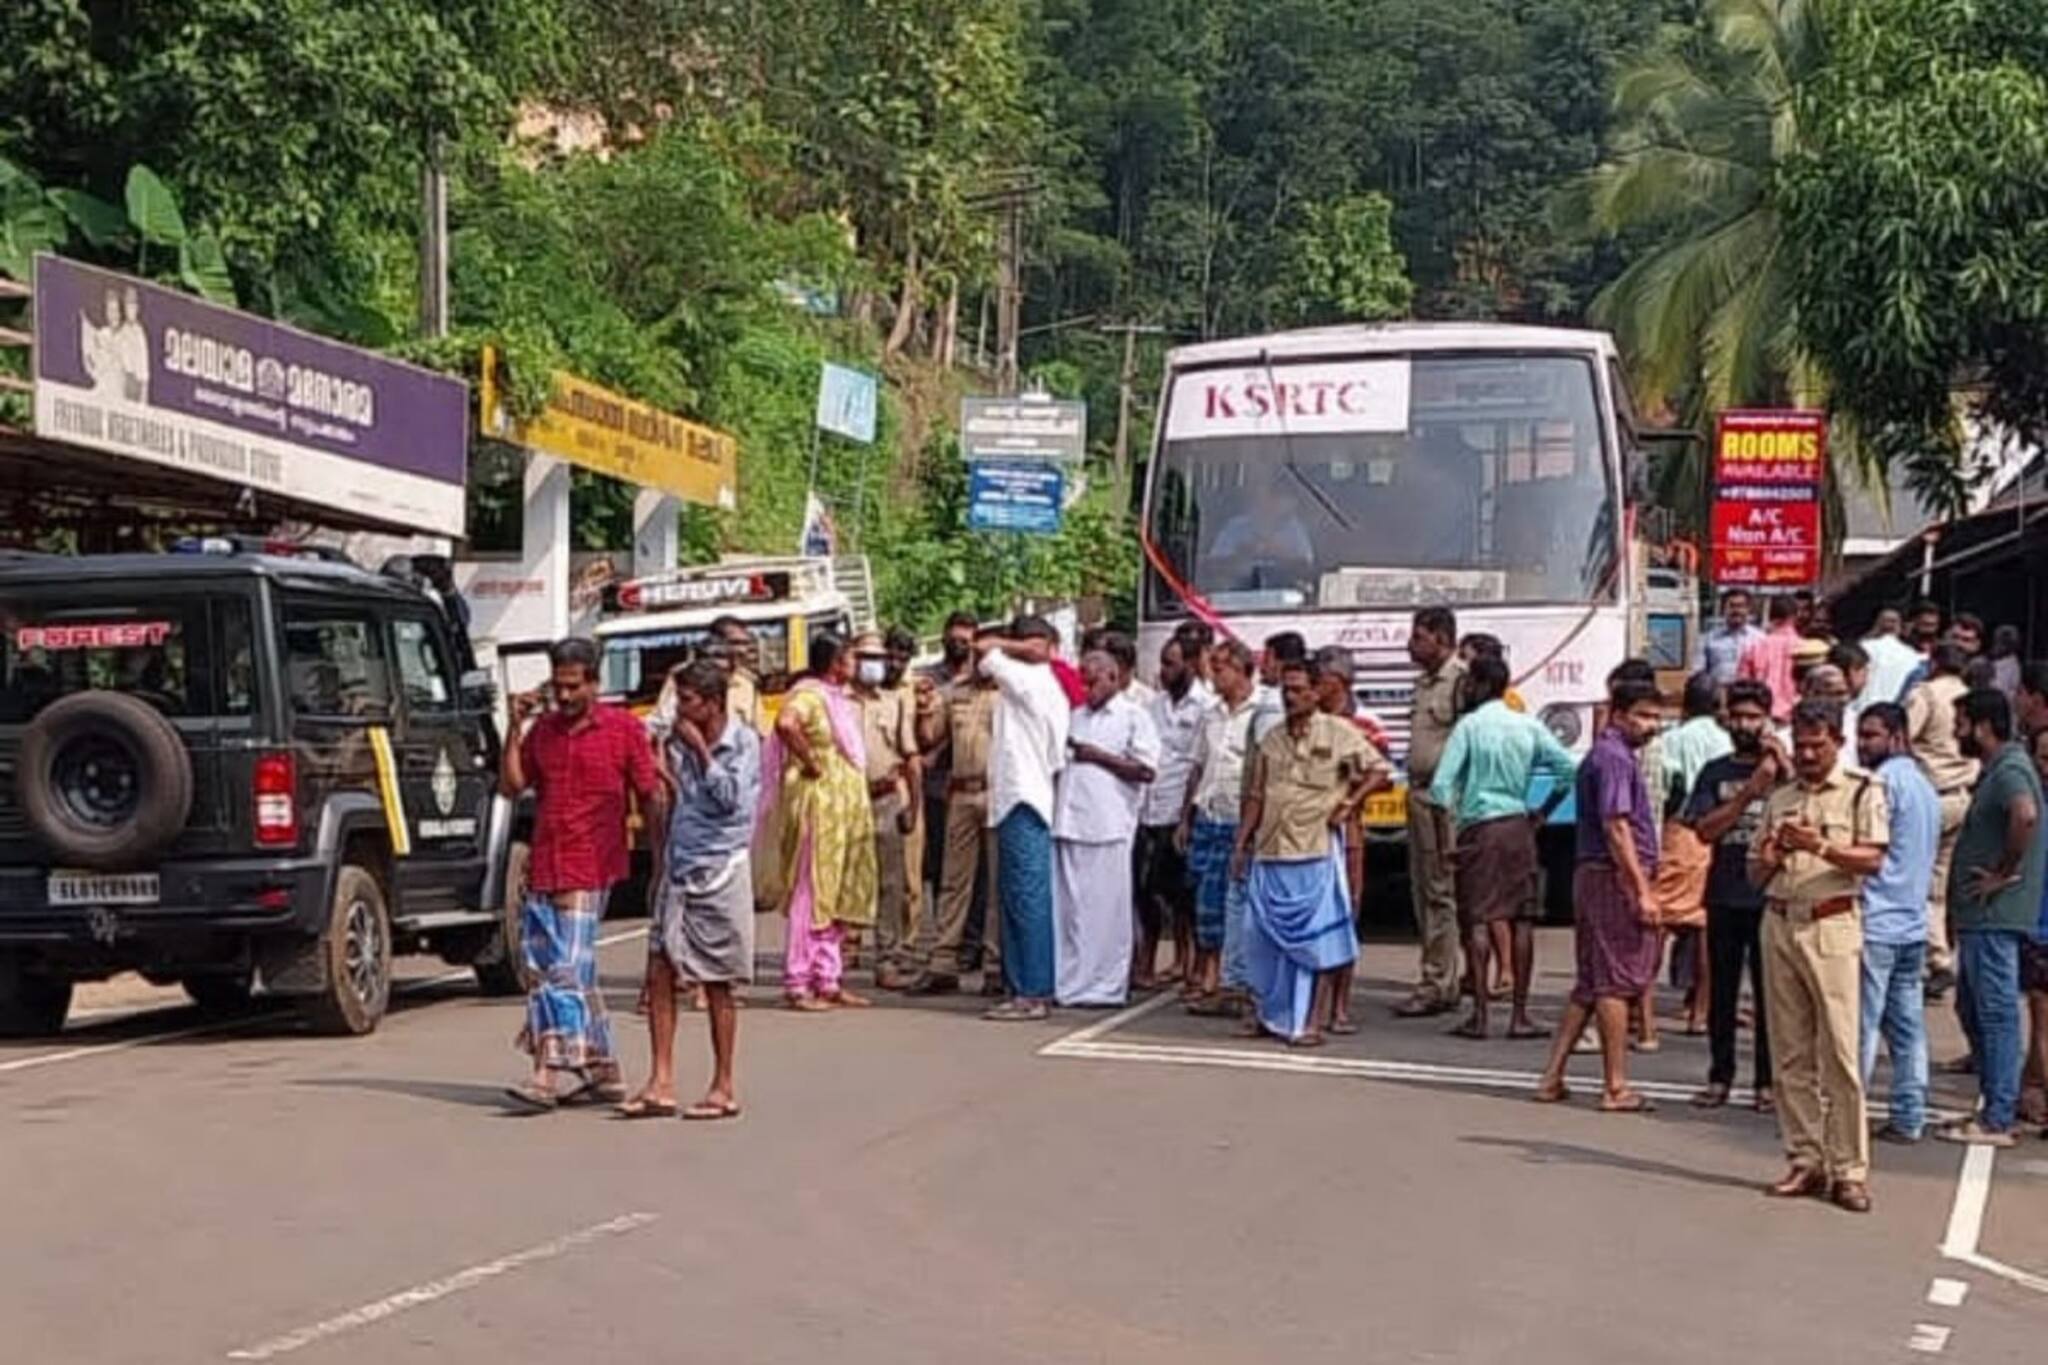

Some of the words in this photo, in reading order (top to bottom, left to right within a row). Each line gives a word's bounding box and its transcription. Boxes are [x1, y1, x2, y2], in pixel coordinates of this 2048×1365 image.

[1205, 381, 1367, 418] KSRTC
[1721, 431, 1818, 462] ROOMS
[1748, 507, 1784, 526] A/C
[1769, 527, 1804, 544] A/C
